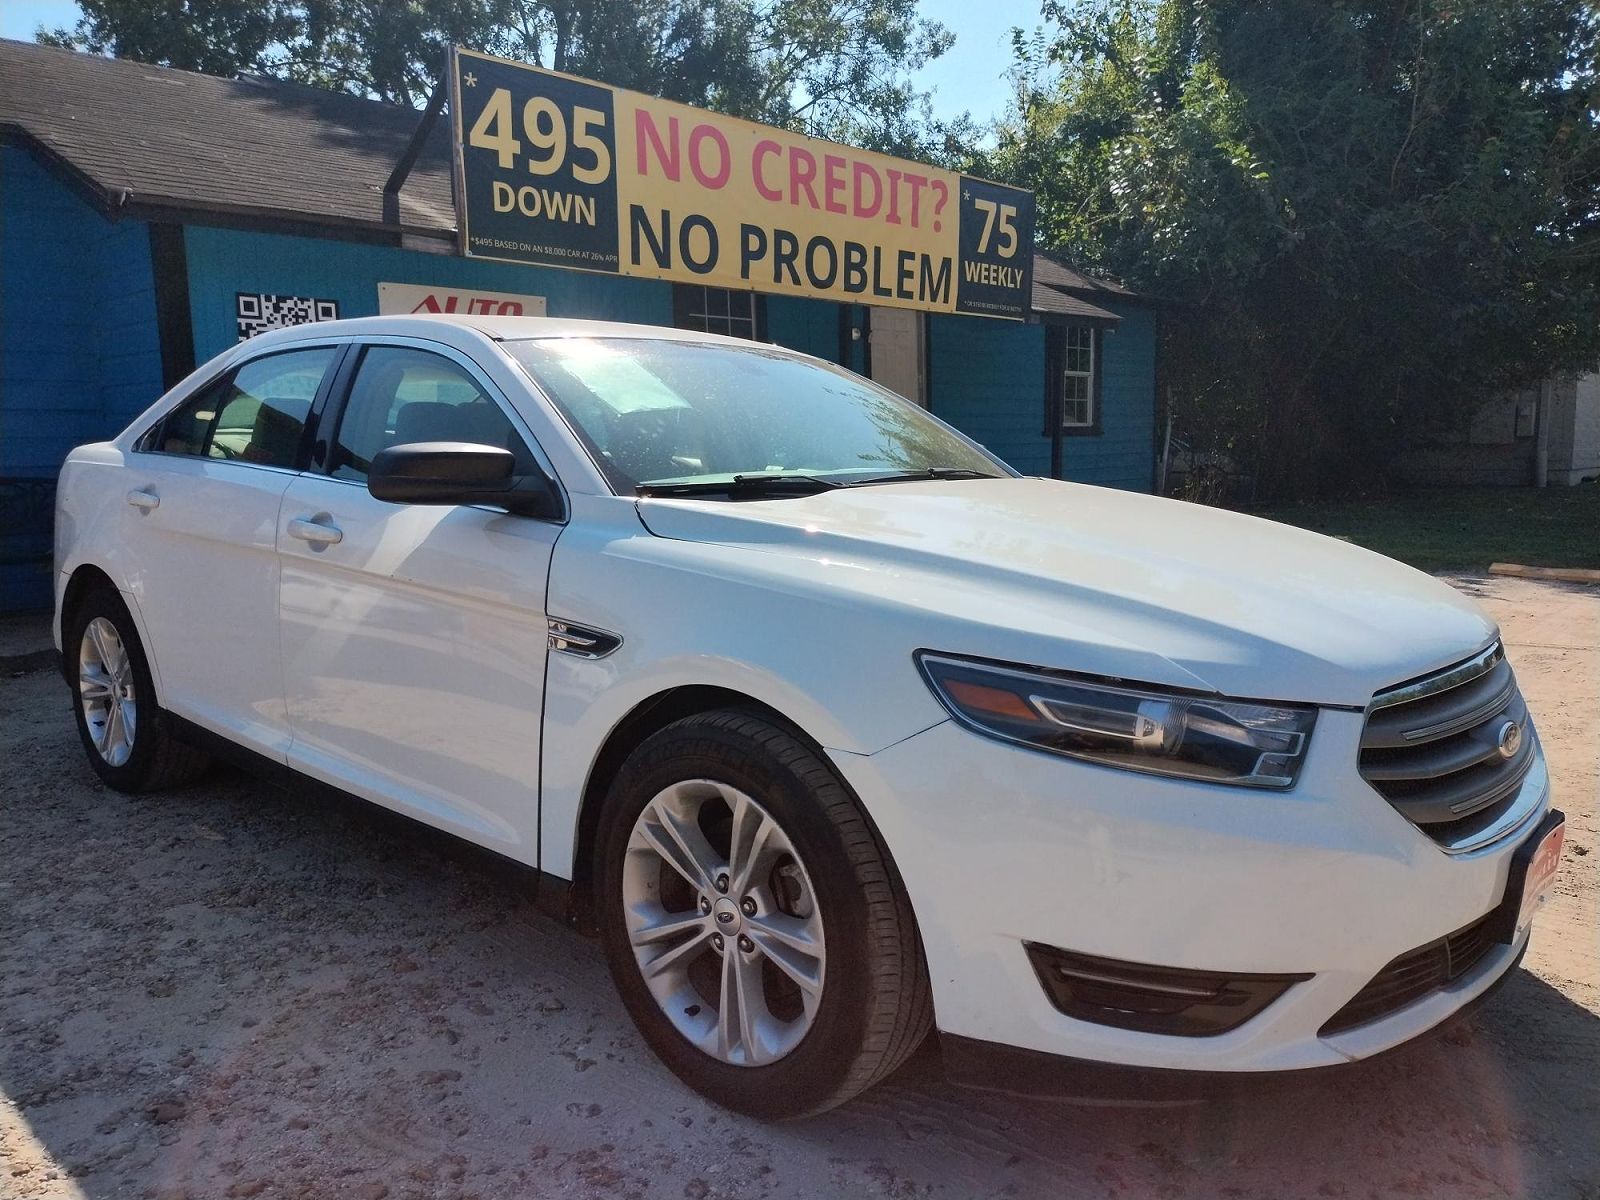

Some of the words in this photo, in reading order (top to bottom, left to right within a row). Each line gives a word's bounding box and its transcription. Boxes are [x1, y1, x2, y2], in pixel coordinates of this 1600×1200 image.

[635, 108, 731, 190] NO
[752, 140, 949, 233] CREDIT?
[493, 181, 596, 226] DOWN
[494, 239, 518, 251] BASED
[519, 242, 531, 252] ON
[532, 244, 543, 253] AN
[567, 249, 580, 258] CAR
[605, 254, 618, 263] APR
[630, 204, 719, 274] NO
[740, 223, 952, 304] PROBLEM
[964, 260, 1023, 289] WEEKLY
